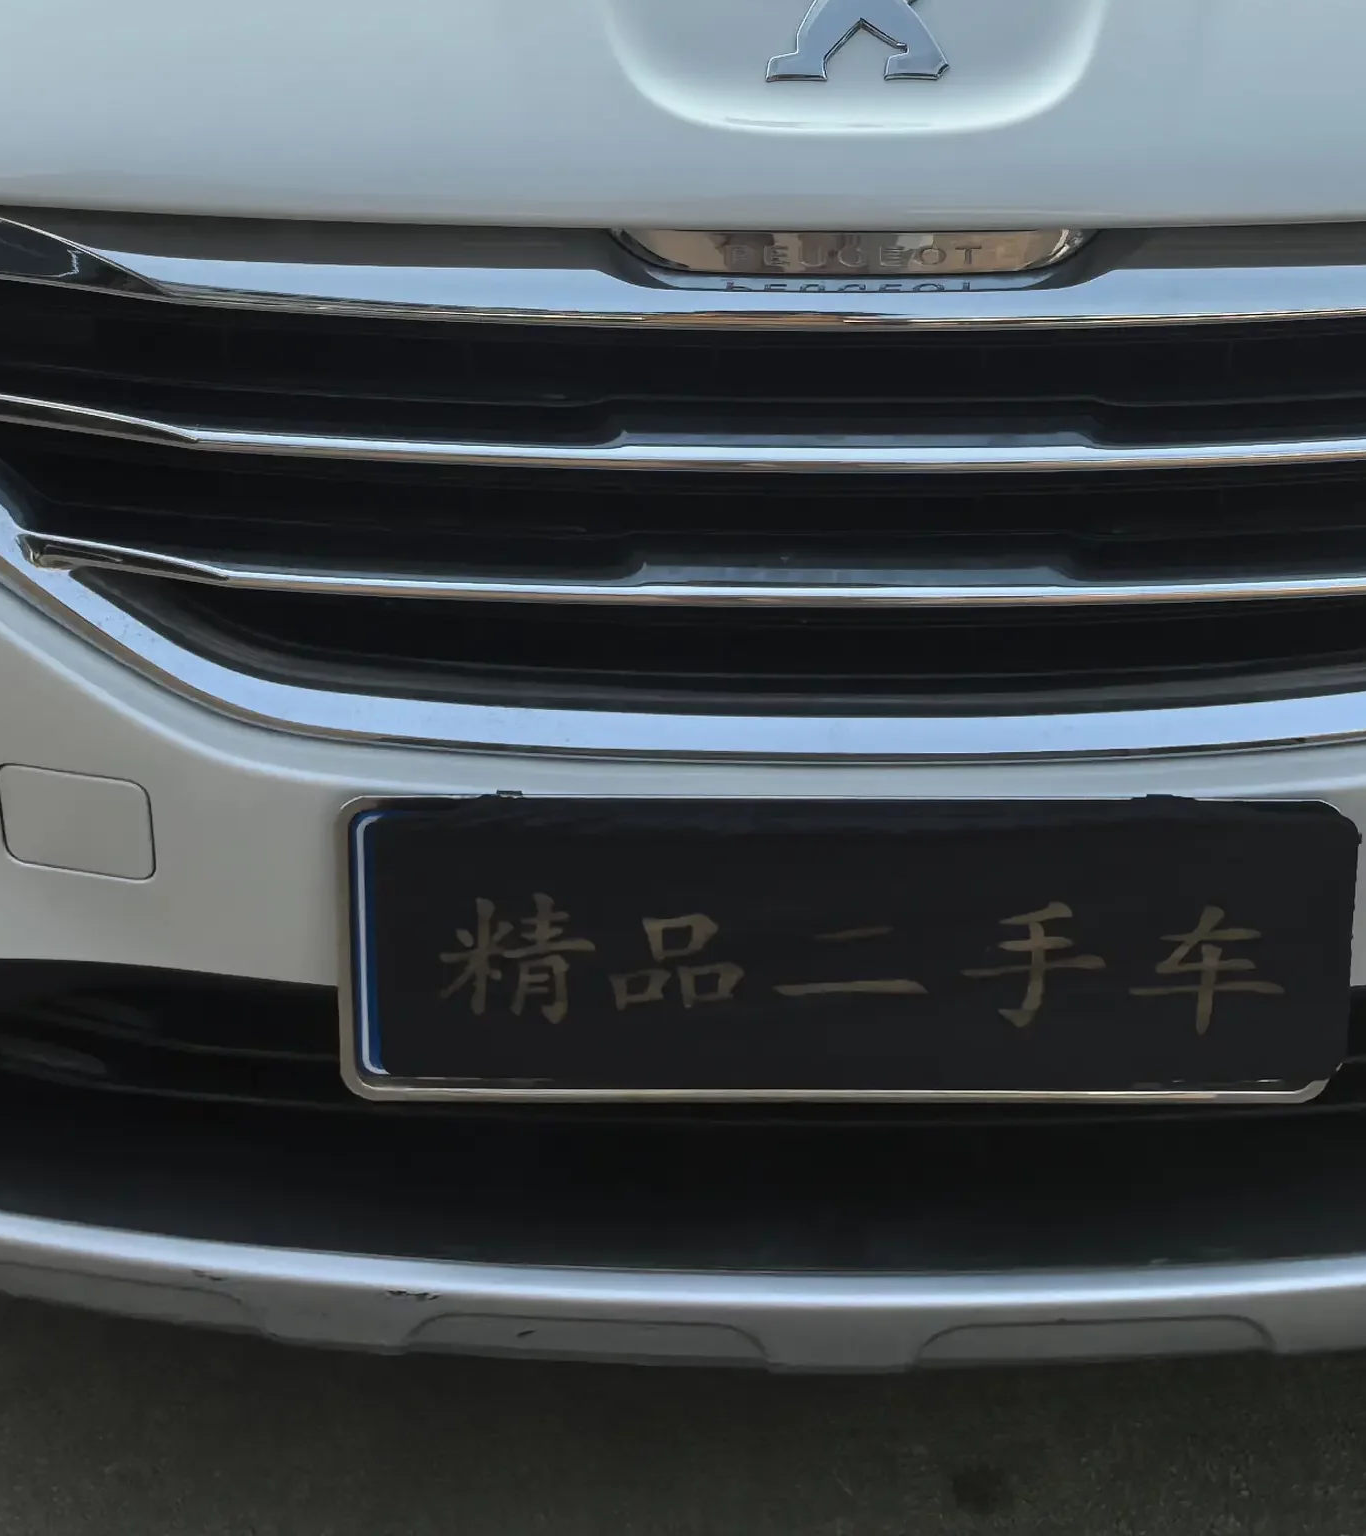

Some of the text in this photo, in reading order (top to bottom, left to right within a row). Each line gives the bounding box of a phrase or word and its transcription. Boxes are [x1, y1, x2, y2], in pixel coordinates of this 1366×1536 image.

[730, 243, 983, 268] PEUGEOT
[439, 891, 1285, 1036] 精品二手车
